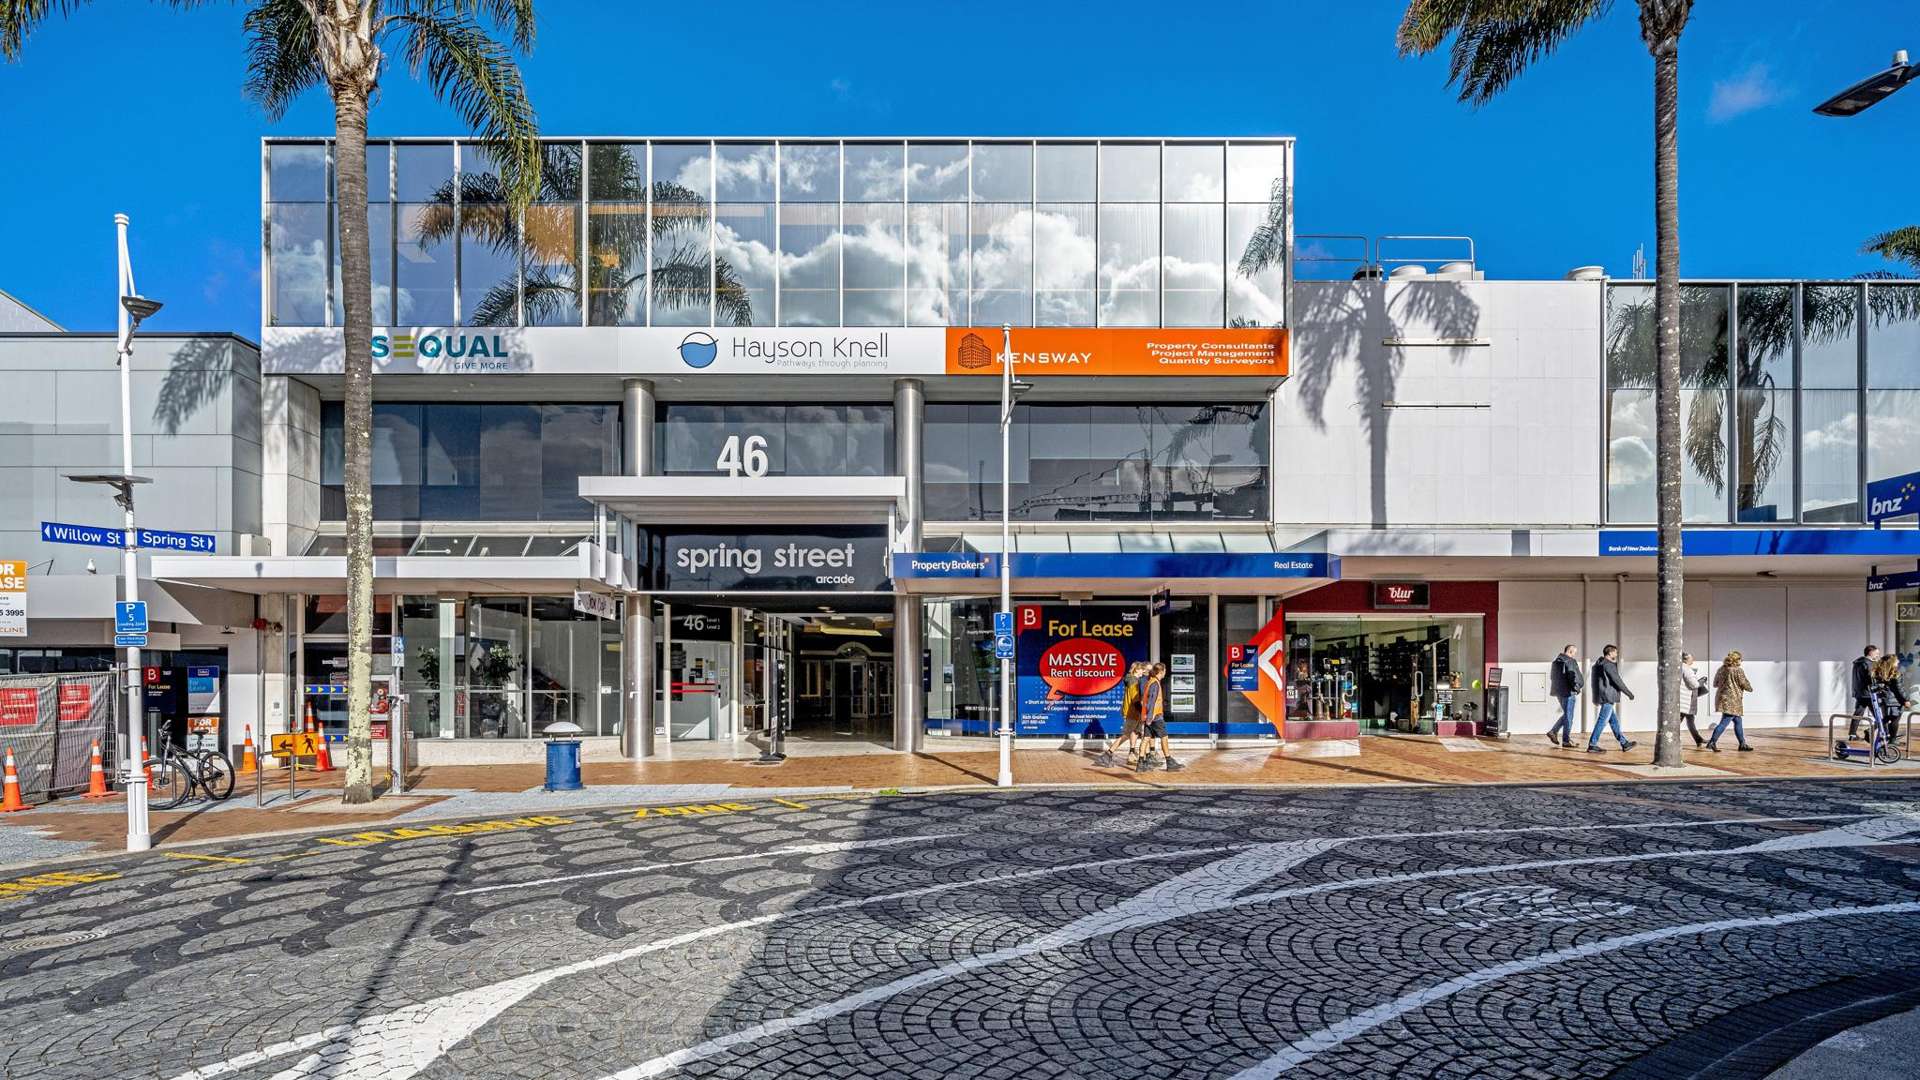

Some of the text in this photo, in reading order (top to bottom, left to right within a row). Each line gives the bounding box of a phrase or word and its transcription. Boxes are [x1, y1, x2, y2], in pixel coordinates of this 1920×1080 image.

[733, 332, 888, 364] Hayson Knell
[1146, 342, 1275, 351] Property Consultants
[996, 352, 1092, 364] KENSWAY
[1151, 350, 1275, 358] Project Management
[454, 362, 509, 370] GIVE MORE
[777, 360, 888, 369] Pathways through planning
[717, 435, 769, 479] 46
[1871, 497, 1902, 516] bnz
[53, 526, 121, 545] Willow St
[142, 532, 205, 549] Spring St
[676, 542, 855, 574] spring street
[1274, 561, 1314, 569] Real Estate
[815, 574, 855, 584] arcade
[1868, 581, 1884, 590] bnz
[1388, 587, 1414, 598] blur
[126, 604, 136, 613] P
[683, 615, 705, 630] 46
[1024, 609, 1036, 625] B
[1048, 620, 1134, 637] For Lease
[1232, 647, 1240, 658] B
[1048, 653, 1117, 666] MASSIVE
[148, 669, 156, 680] B
[1050, 668, 1115, 677] Rent discount
